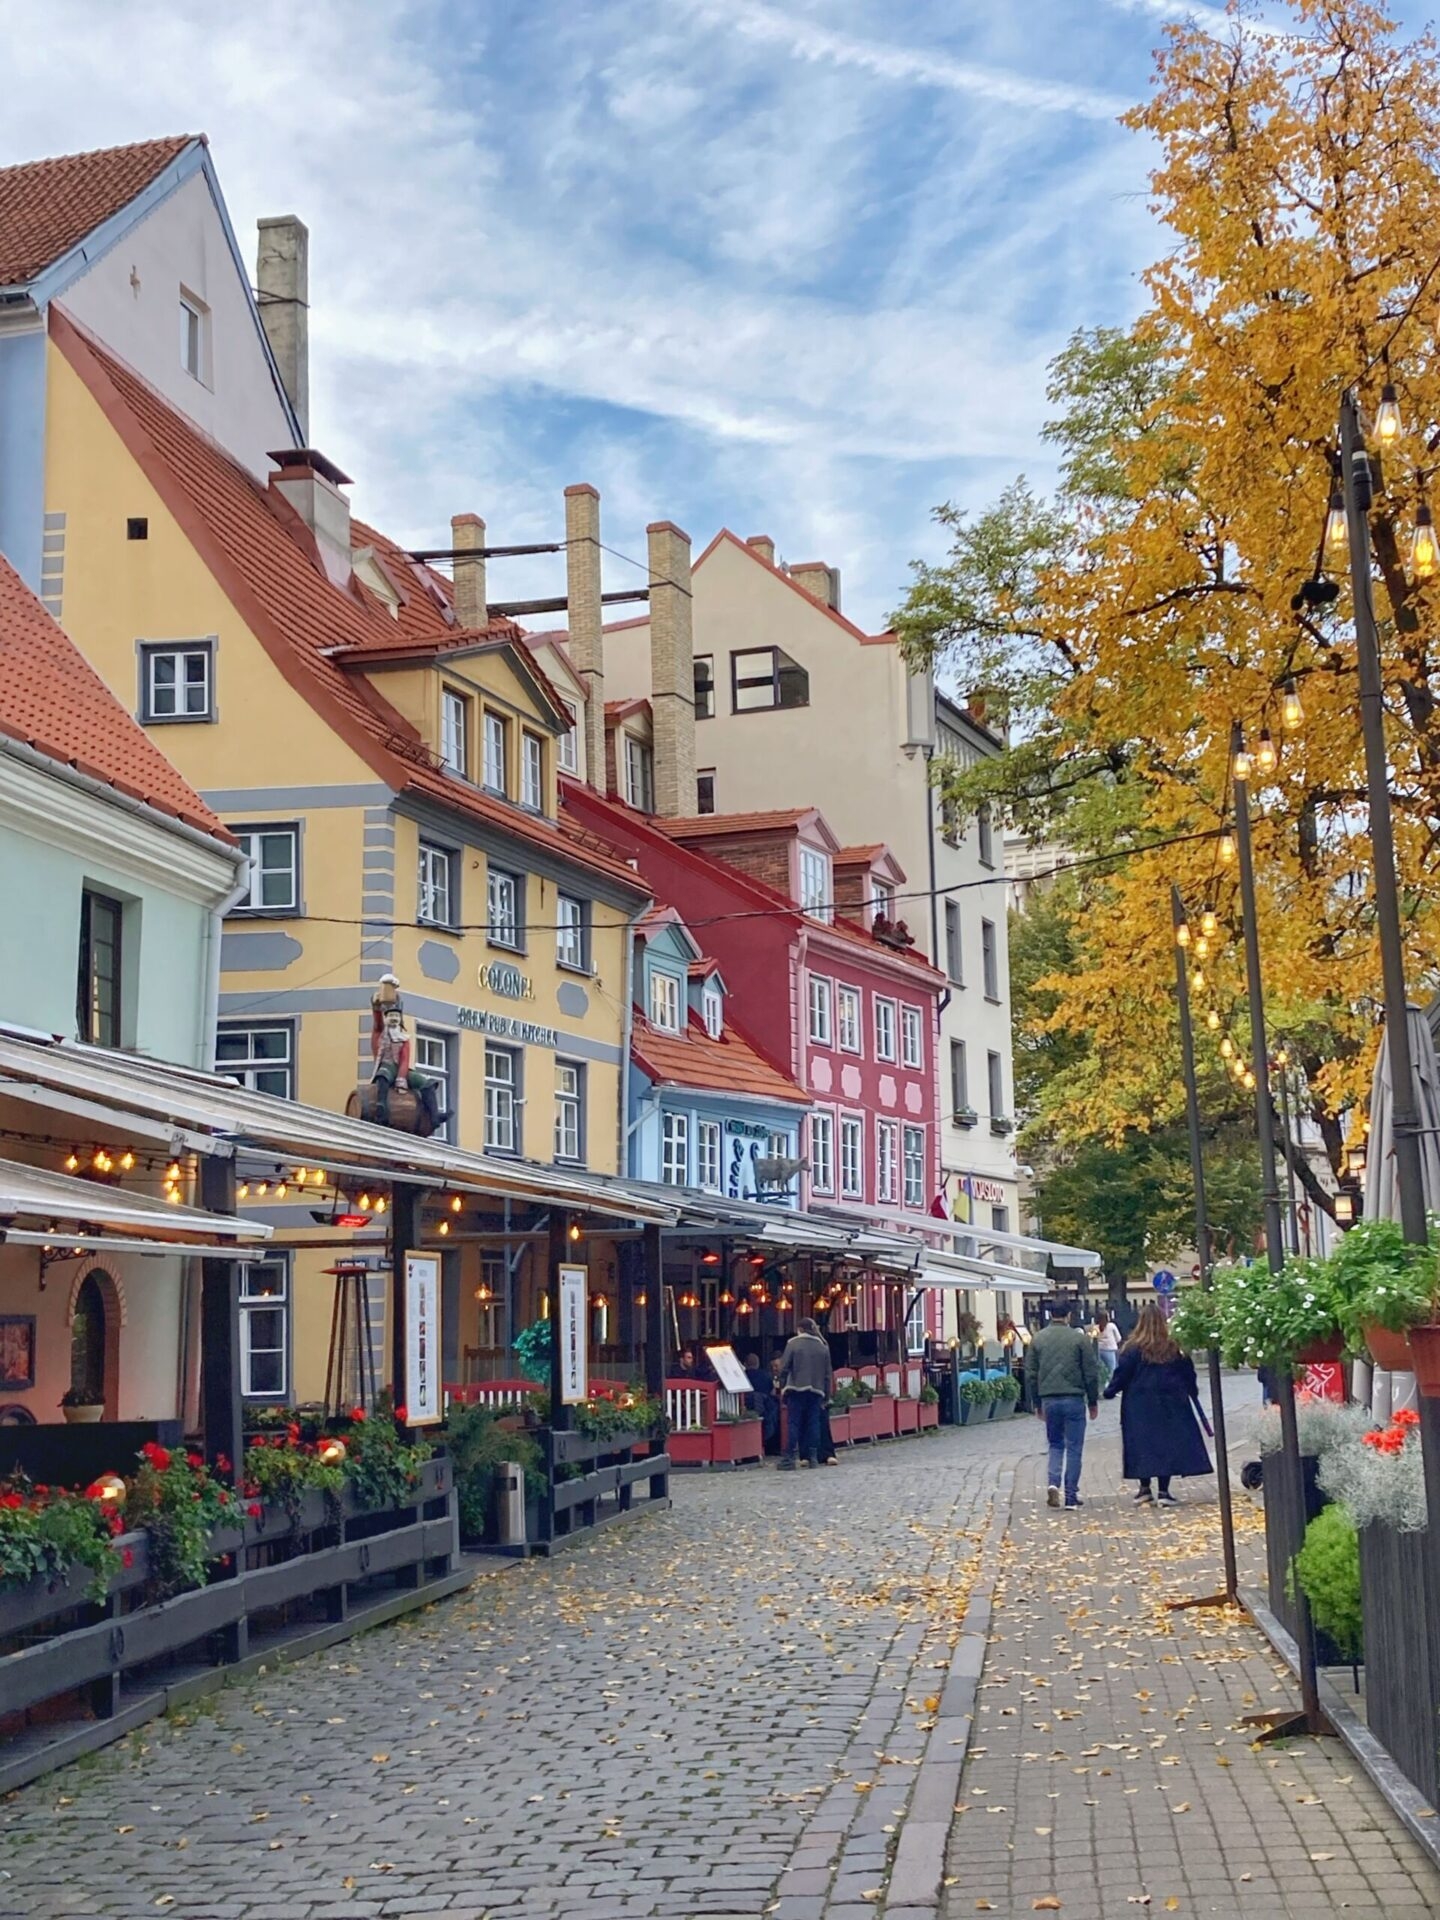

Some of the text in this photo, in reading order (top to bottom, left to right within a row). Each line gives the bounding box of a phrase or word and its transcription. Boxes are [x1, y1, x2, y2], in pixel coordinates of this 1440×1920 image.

[478, 963, 535, 1000] COLONEL
[488, 1014, 507, 1035] PUB
[508, 1019, 518, 1037] &
[520, 1022, 558, 1046] KITCHEN
